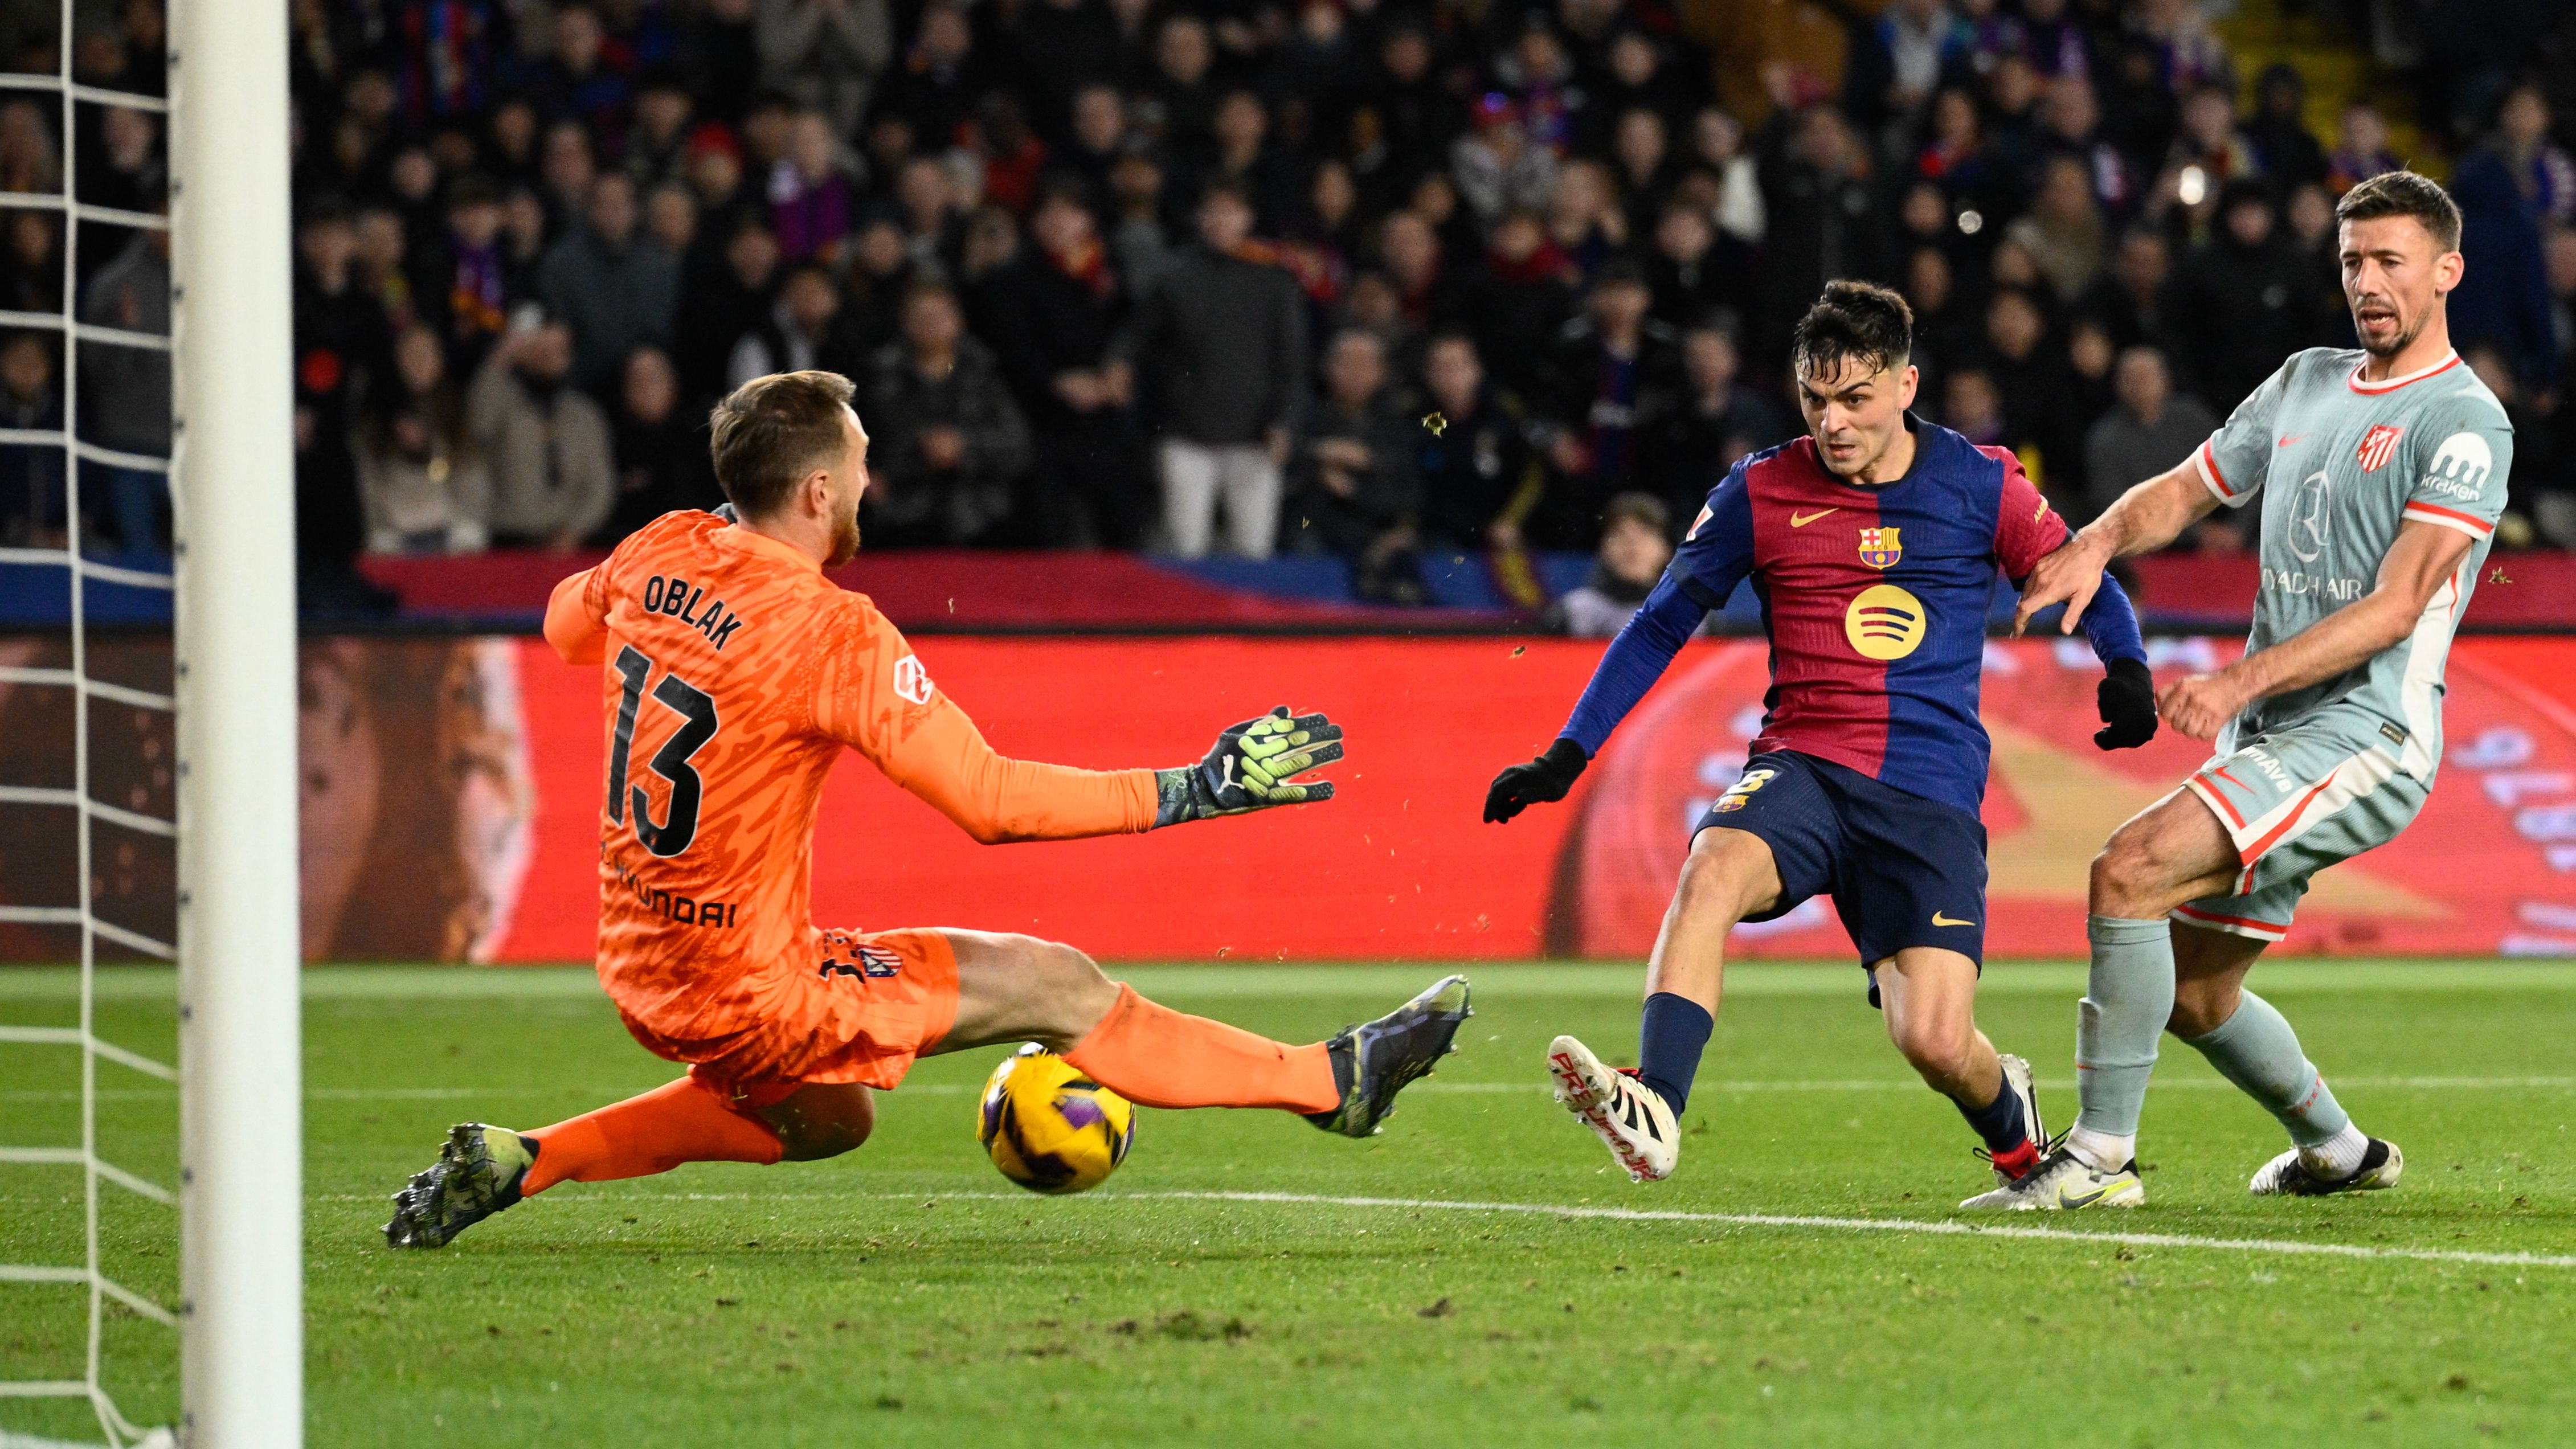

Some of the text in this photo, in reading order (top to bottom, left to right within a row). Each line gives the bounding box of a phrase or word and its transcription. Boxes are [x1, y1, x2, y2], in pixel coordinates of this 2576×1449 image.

[2421, 474, 2480, 501] kraken
[2262, 568, 2362, 600] IYADH AIR
[644, 575, 743, 652] OBLAK
[608, 644, 720, 859] 13
